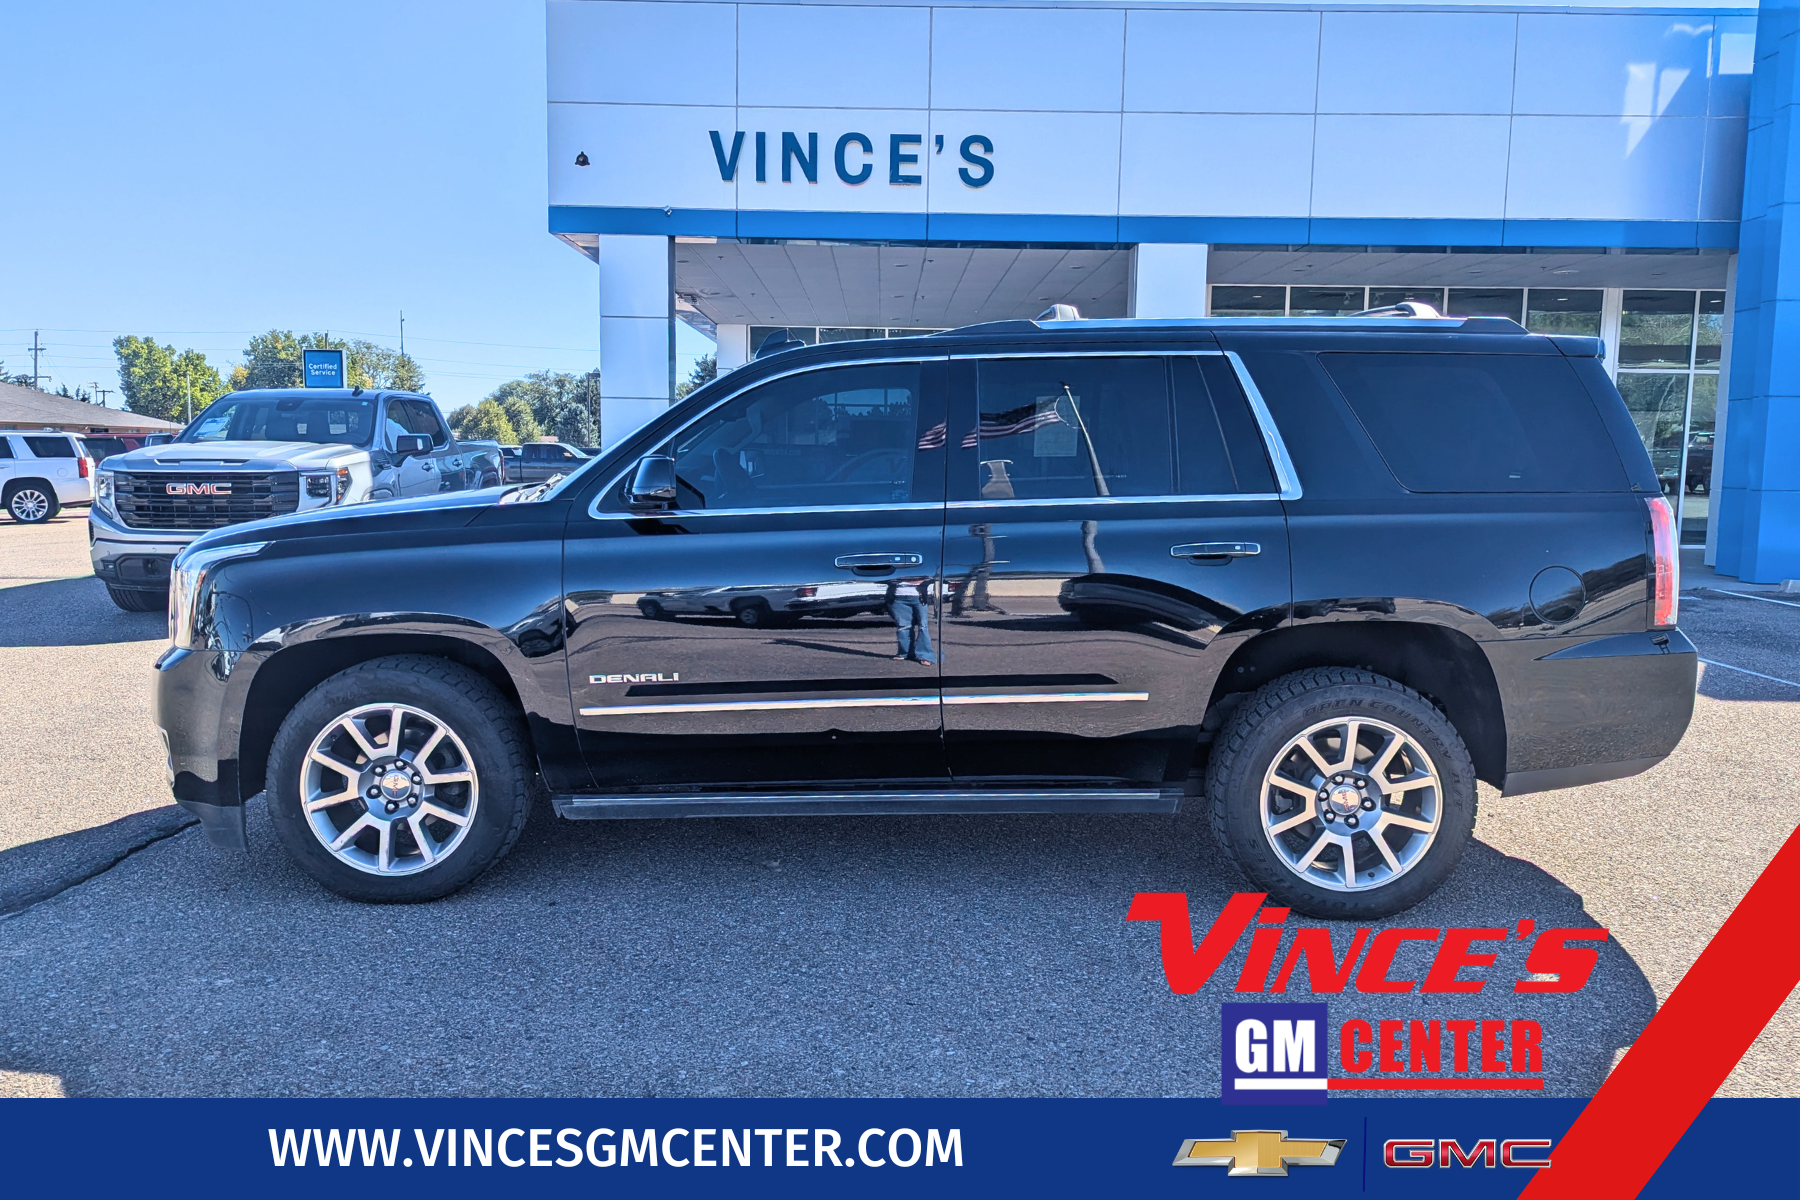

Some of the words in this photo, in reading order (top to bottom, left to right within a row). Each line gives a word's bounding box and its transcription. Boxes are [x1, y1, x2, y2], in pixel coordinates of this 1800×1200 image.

[709, 131, 995, 188] VINCE'S
[166, 482, 232, 495] GMC
[589, 672, 679, 684] DENALI
[1302, 698, 1363, 718] OPEN
[1369, 700, 1452, 761] COUNTRY
